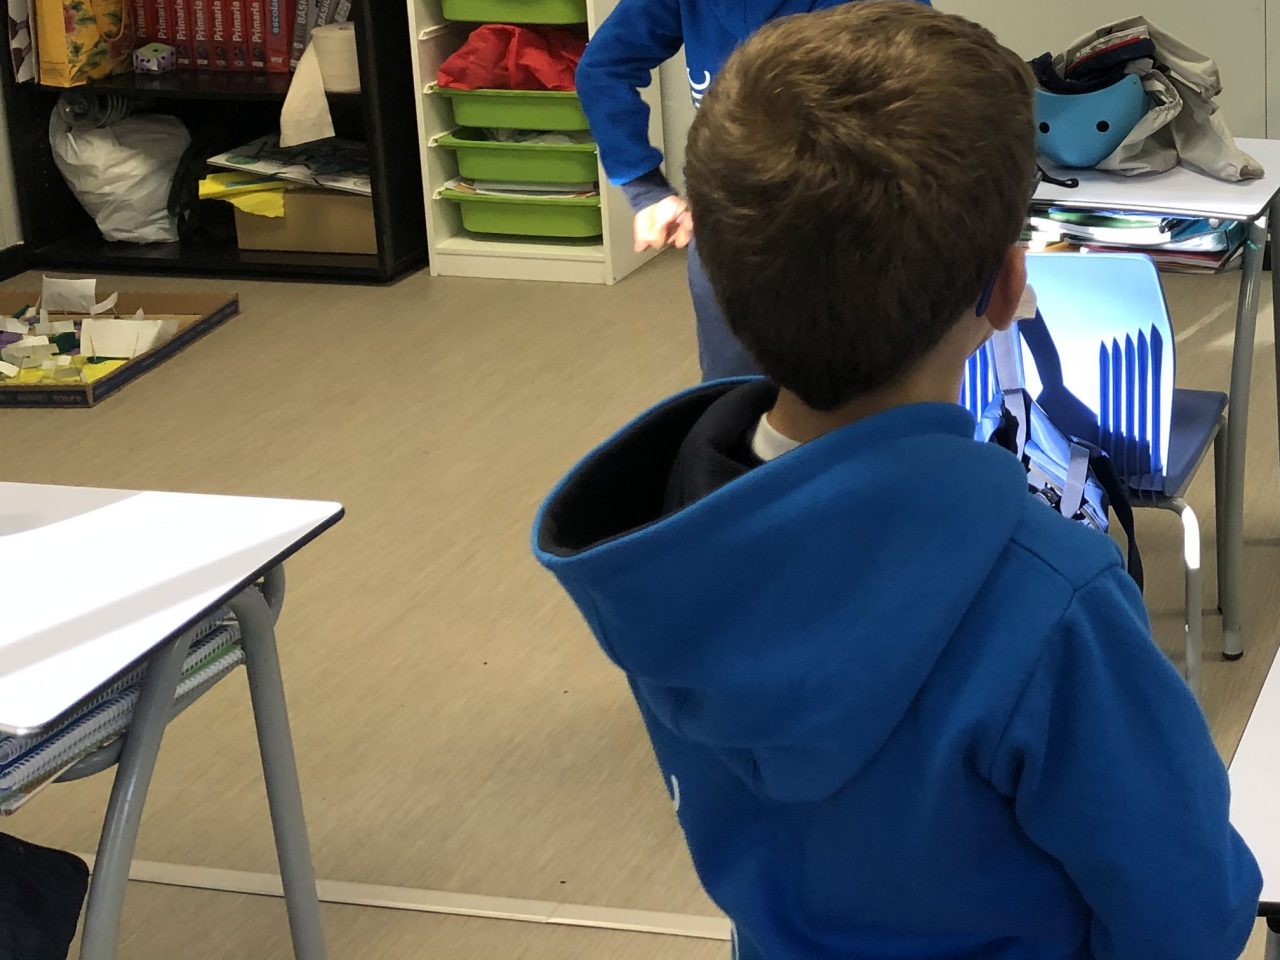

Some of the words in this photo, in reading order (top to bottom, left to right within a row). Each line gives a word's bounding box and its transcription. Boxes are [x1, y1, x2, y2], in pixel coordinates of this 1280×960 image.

[175, 0, 187, 41] Primaria
[195, 0, 206, 41] Primaria
[213, 0, 225, 42] Primaria
[231, 1, 243, 42] Primaria
[252, 1, 262, 43] Primaria
